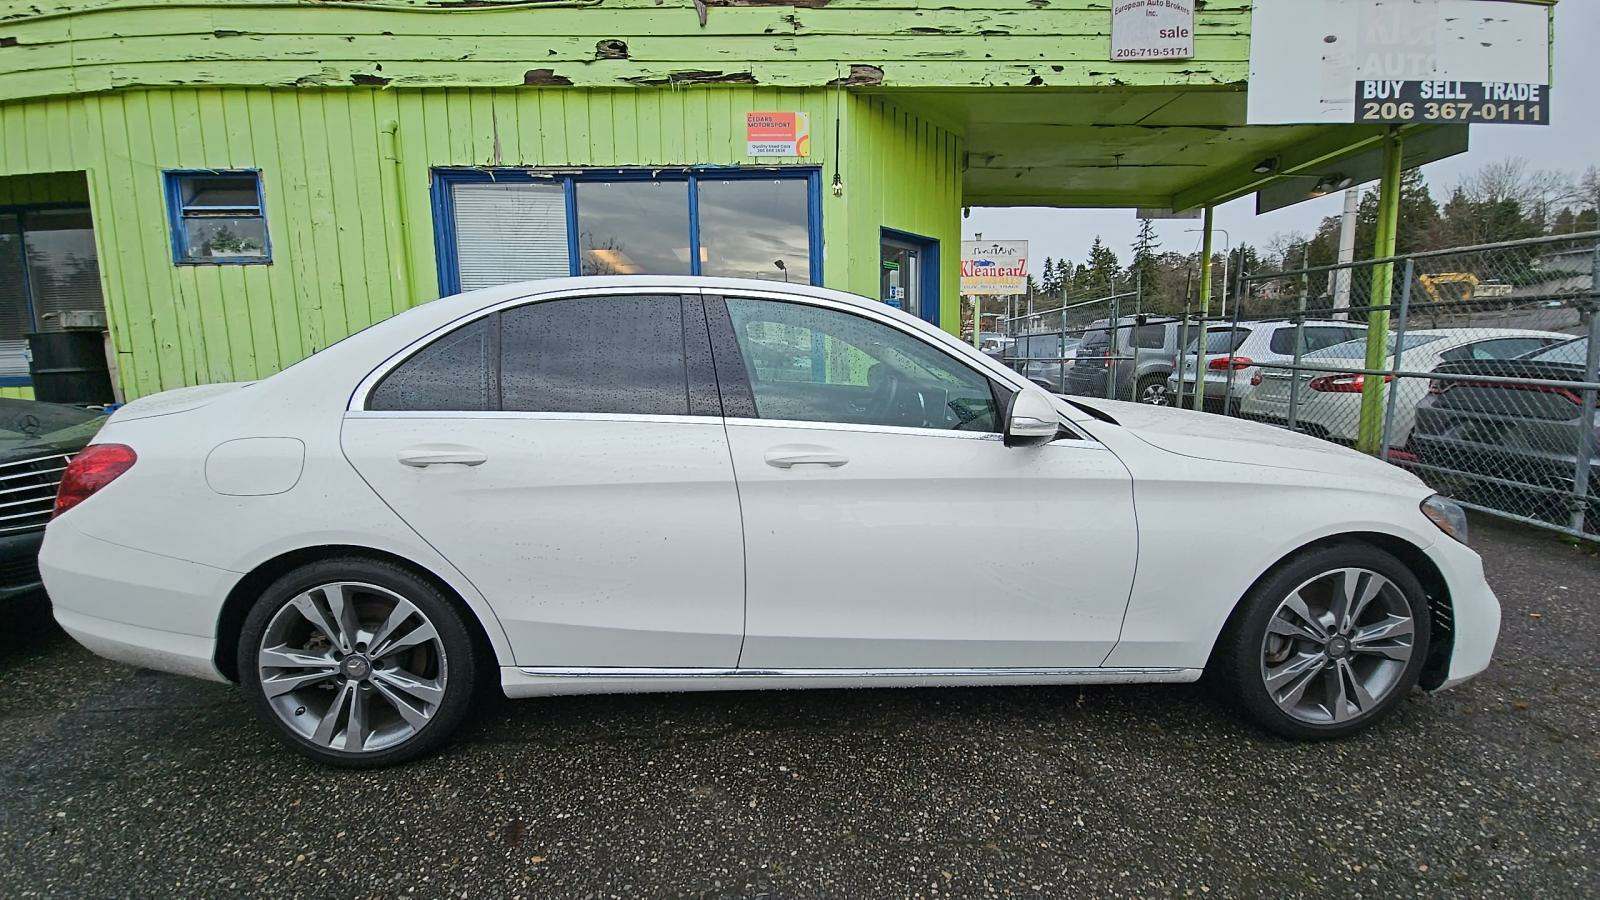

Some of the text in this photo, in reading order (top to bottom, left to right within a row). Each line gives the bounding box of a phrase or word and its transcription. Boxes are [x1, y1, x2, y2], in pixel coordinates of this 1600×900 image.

[1115, 1, 1145, 16] European
[1166, 1, 1190, 15] Brokers
[1146, 9, 1158, 17] Inc.
[1160, 26, 1189, 38] sale
[1117, 48, 1188, 57] 206-719-5171
[1363, 81, 1540, 102] BUY SELL TRADE
[1363, 102, 1540, 121] 206 367-0111
